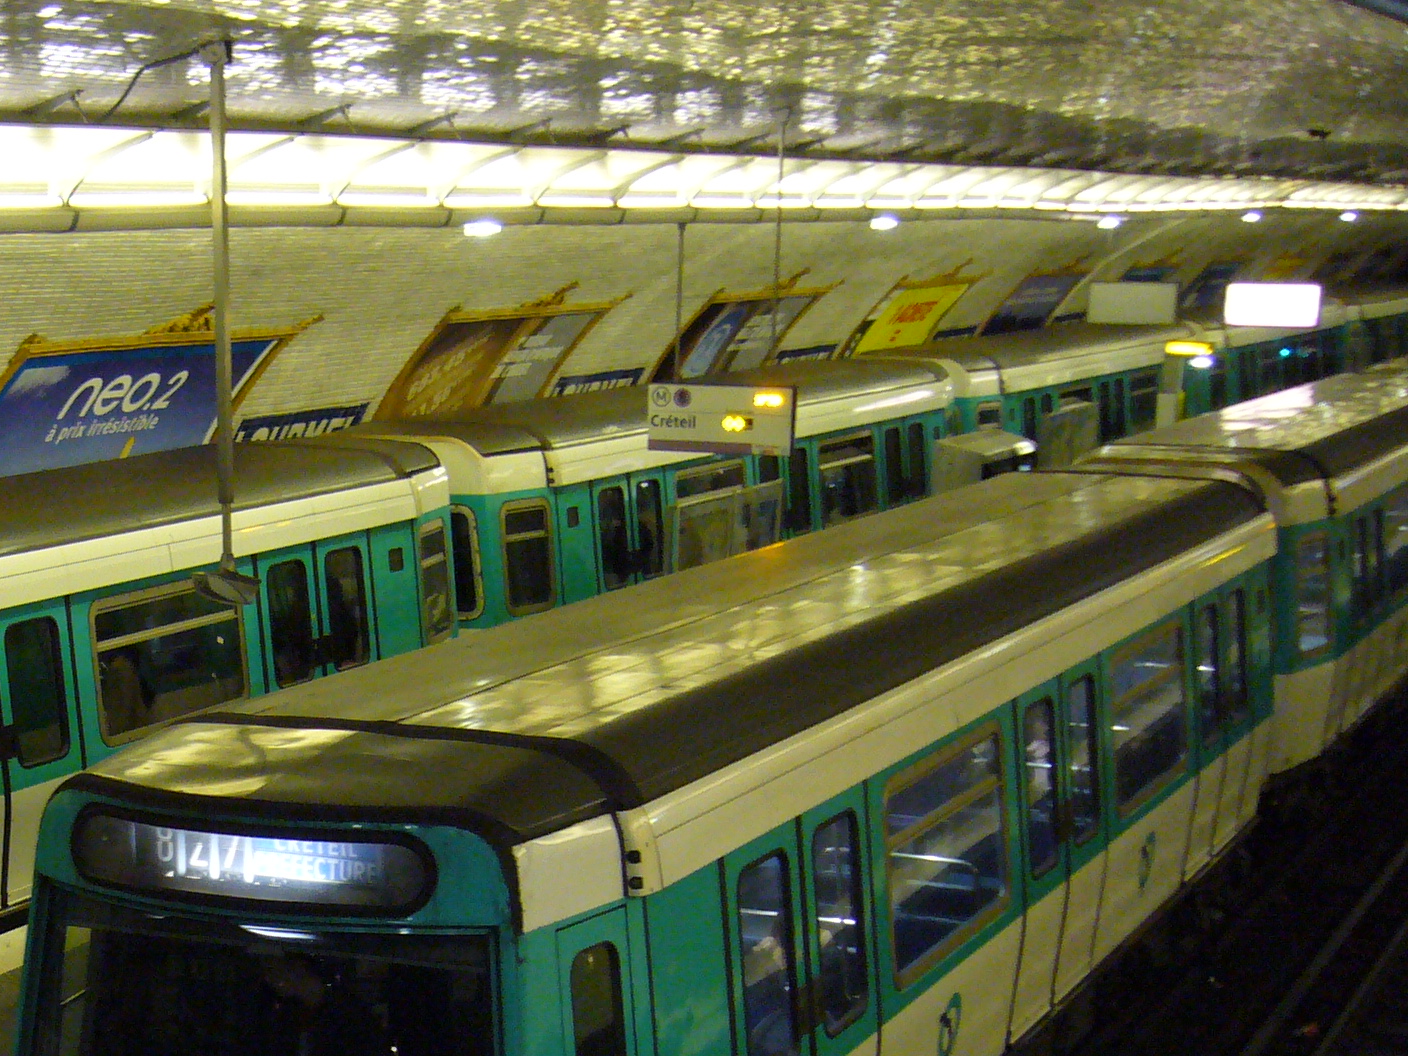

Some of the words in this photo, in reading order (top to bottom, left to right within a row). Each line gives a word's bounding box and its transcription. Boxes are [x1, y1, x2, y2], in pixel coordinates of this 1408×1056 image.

[56, 370, 190, 420] neo.2
[45, 424, 58, 443] à
[55, 421, 87, 445] prix
[87, 413, 160, 437] irrésistible
[650, 414, 696, 429] Créteil
[253, 850, 378, 884] EFECTURE
